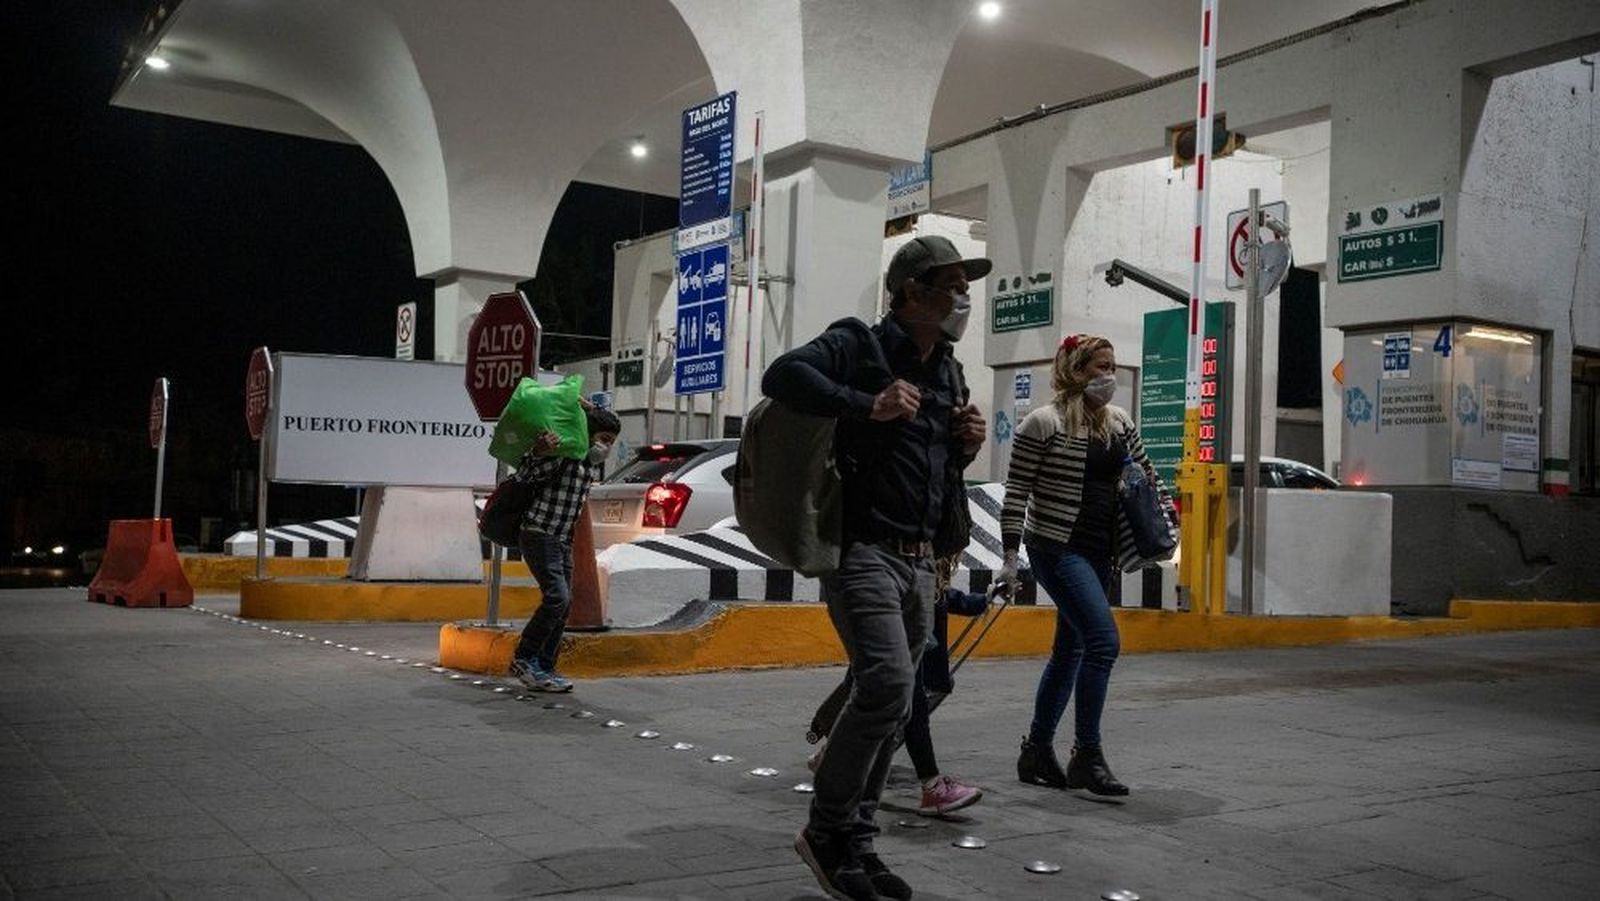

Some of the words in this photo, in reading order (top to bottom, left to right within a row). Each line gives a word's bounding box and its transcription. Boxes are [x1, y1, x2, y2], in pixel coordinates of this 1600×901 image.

[688, 97, 731, 125] TARIFAS
[1344, 237, 1381, 252] AUTOS
[1344, 260, 1367, 273] CAR
[478, 323, 525, 352] ALTO
[1433, 325, 1452, 357] 4
[474, 360, 523, 389] STOP
[683, 360, 717, 375] SERVICIOS
[680, 373, 718, 388] AUXILIARES
[284, 415, 362, 433] PUERTO
[367, 418, 485, 439] FRONTERIZO
